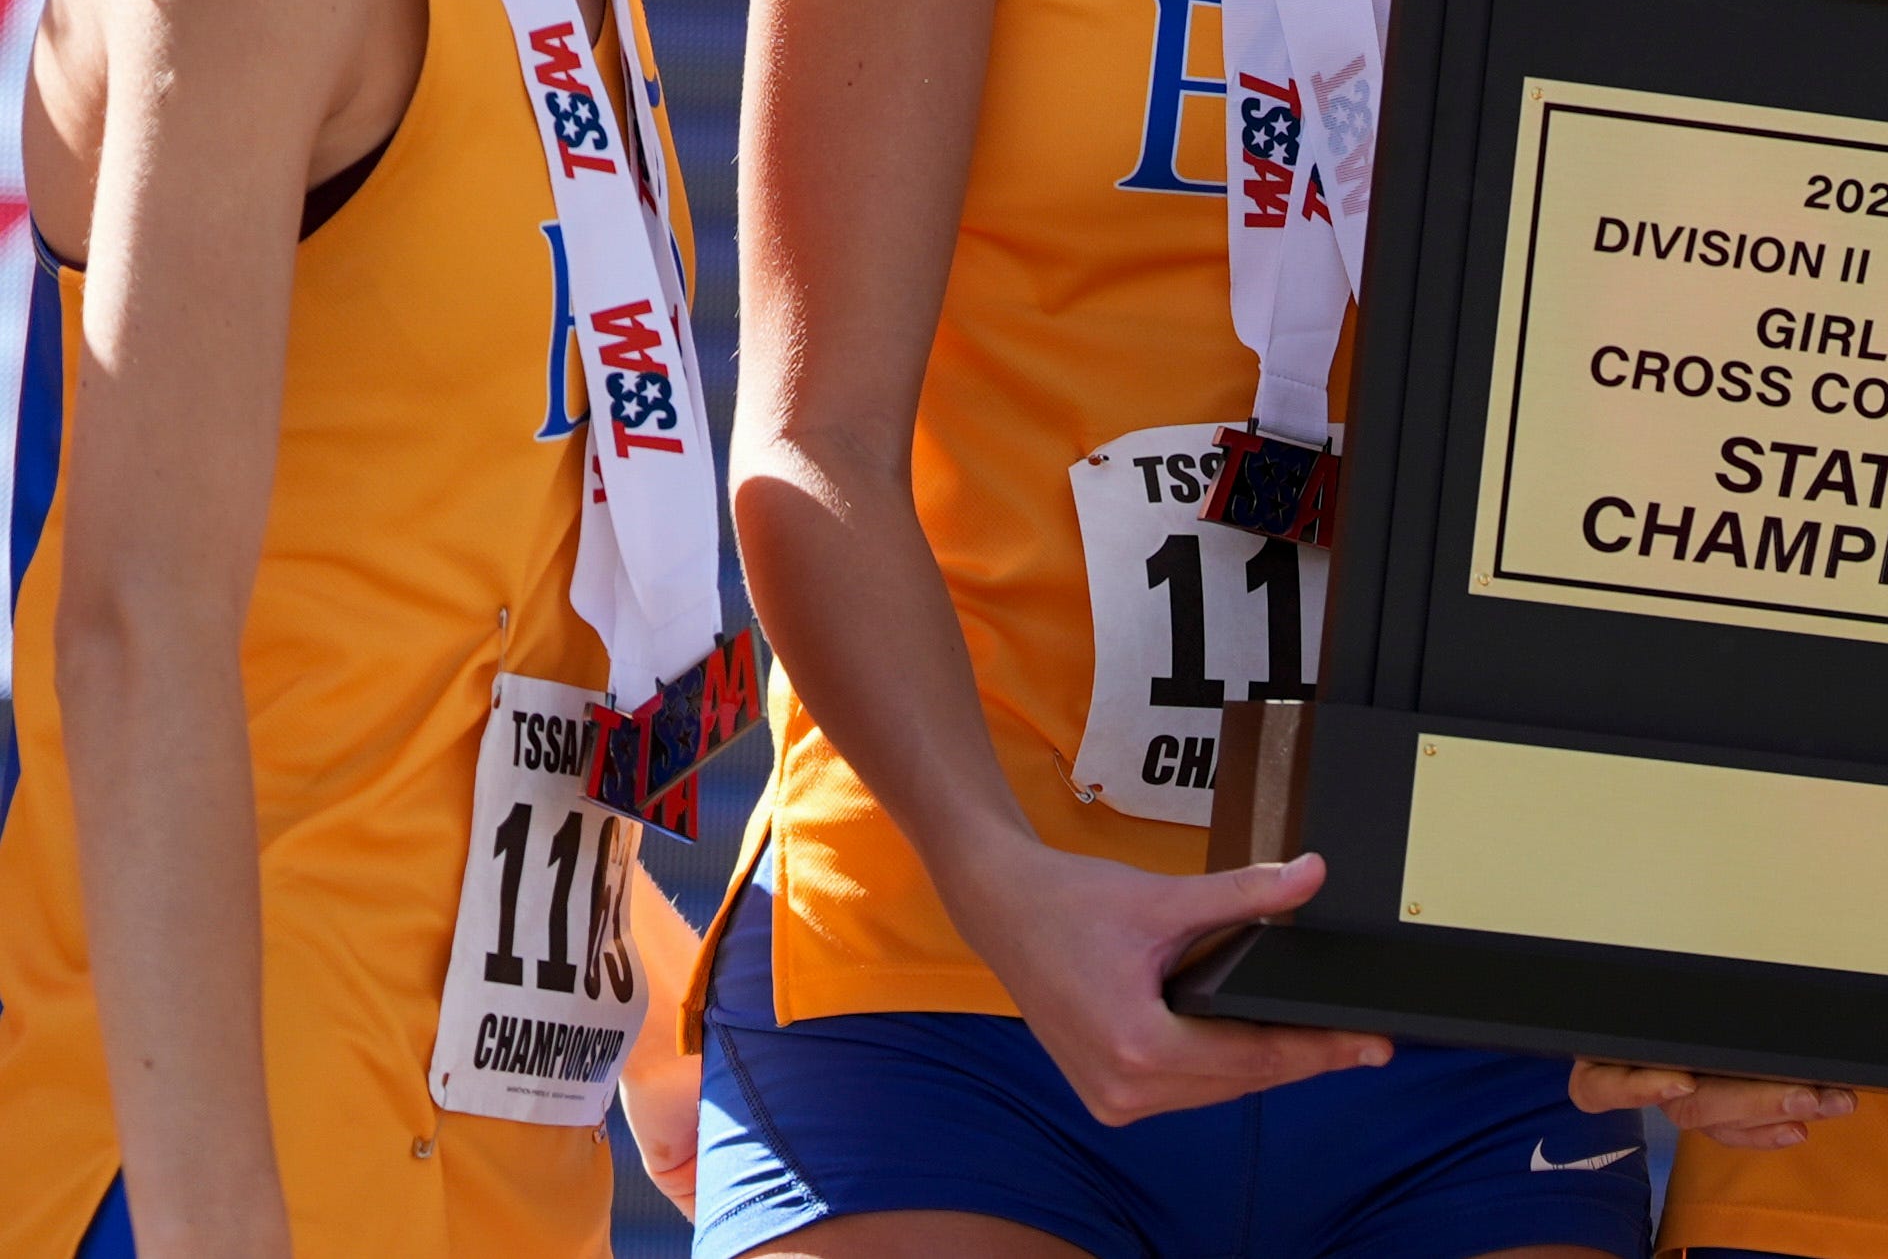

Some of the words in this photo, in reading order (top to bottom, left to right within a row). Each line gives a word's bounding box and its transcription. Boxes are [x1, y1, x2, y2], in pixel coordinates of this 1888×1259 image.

[529, 21, 616, 179] TSSAA
[1239, 72, 1302, 228] TSSAA
[1593, 216, 1825, 279] DIVISION
[1840, 249, 1870, 284] II
[590, 299, 684, 459] TSSAA
[1590, 345, 1792, 407] CROSS
